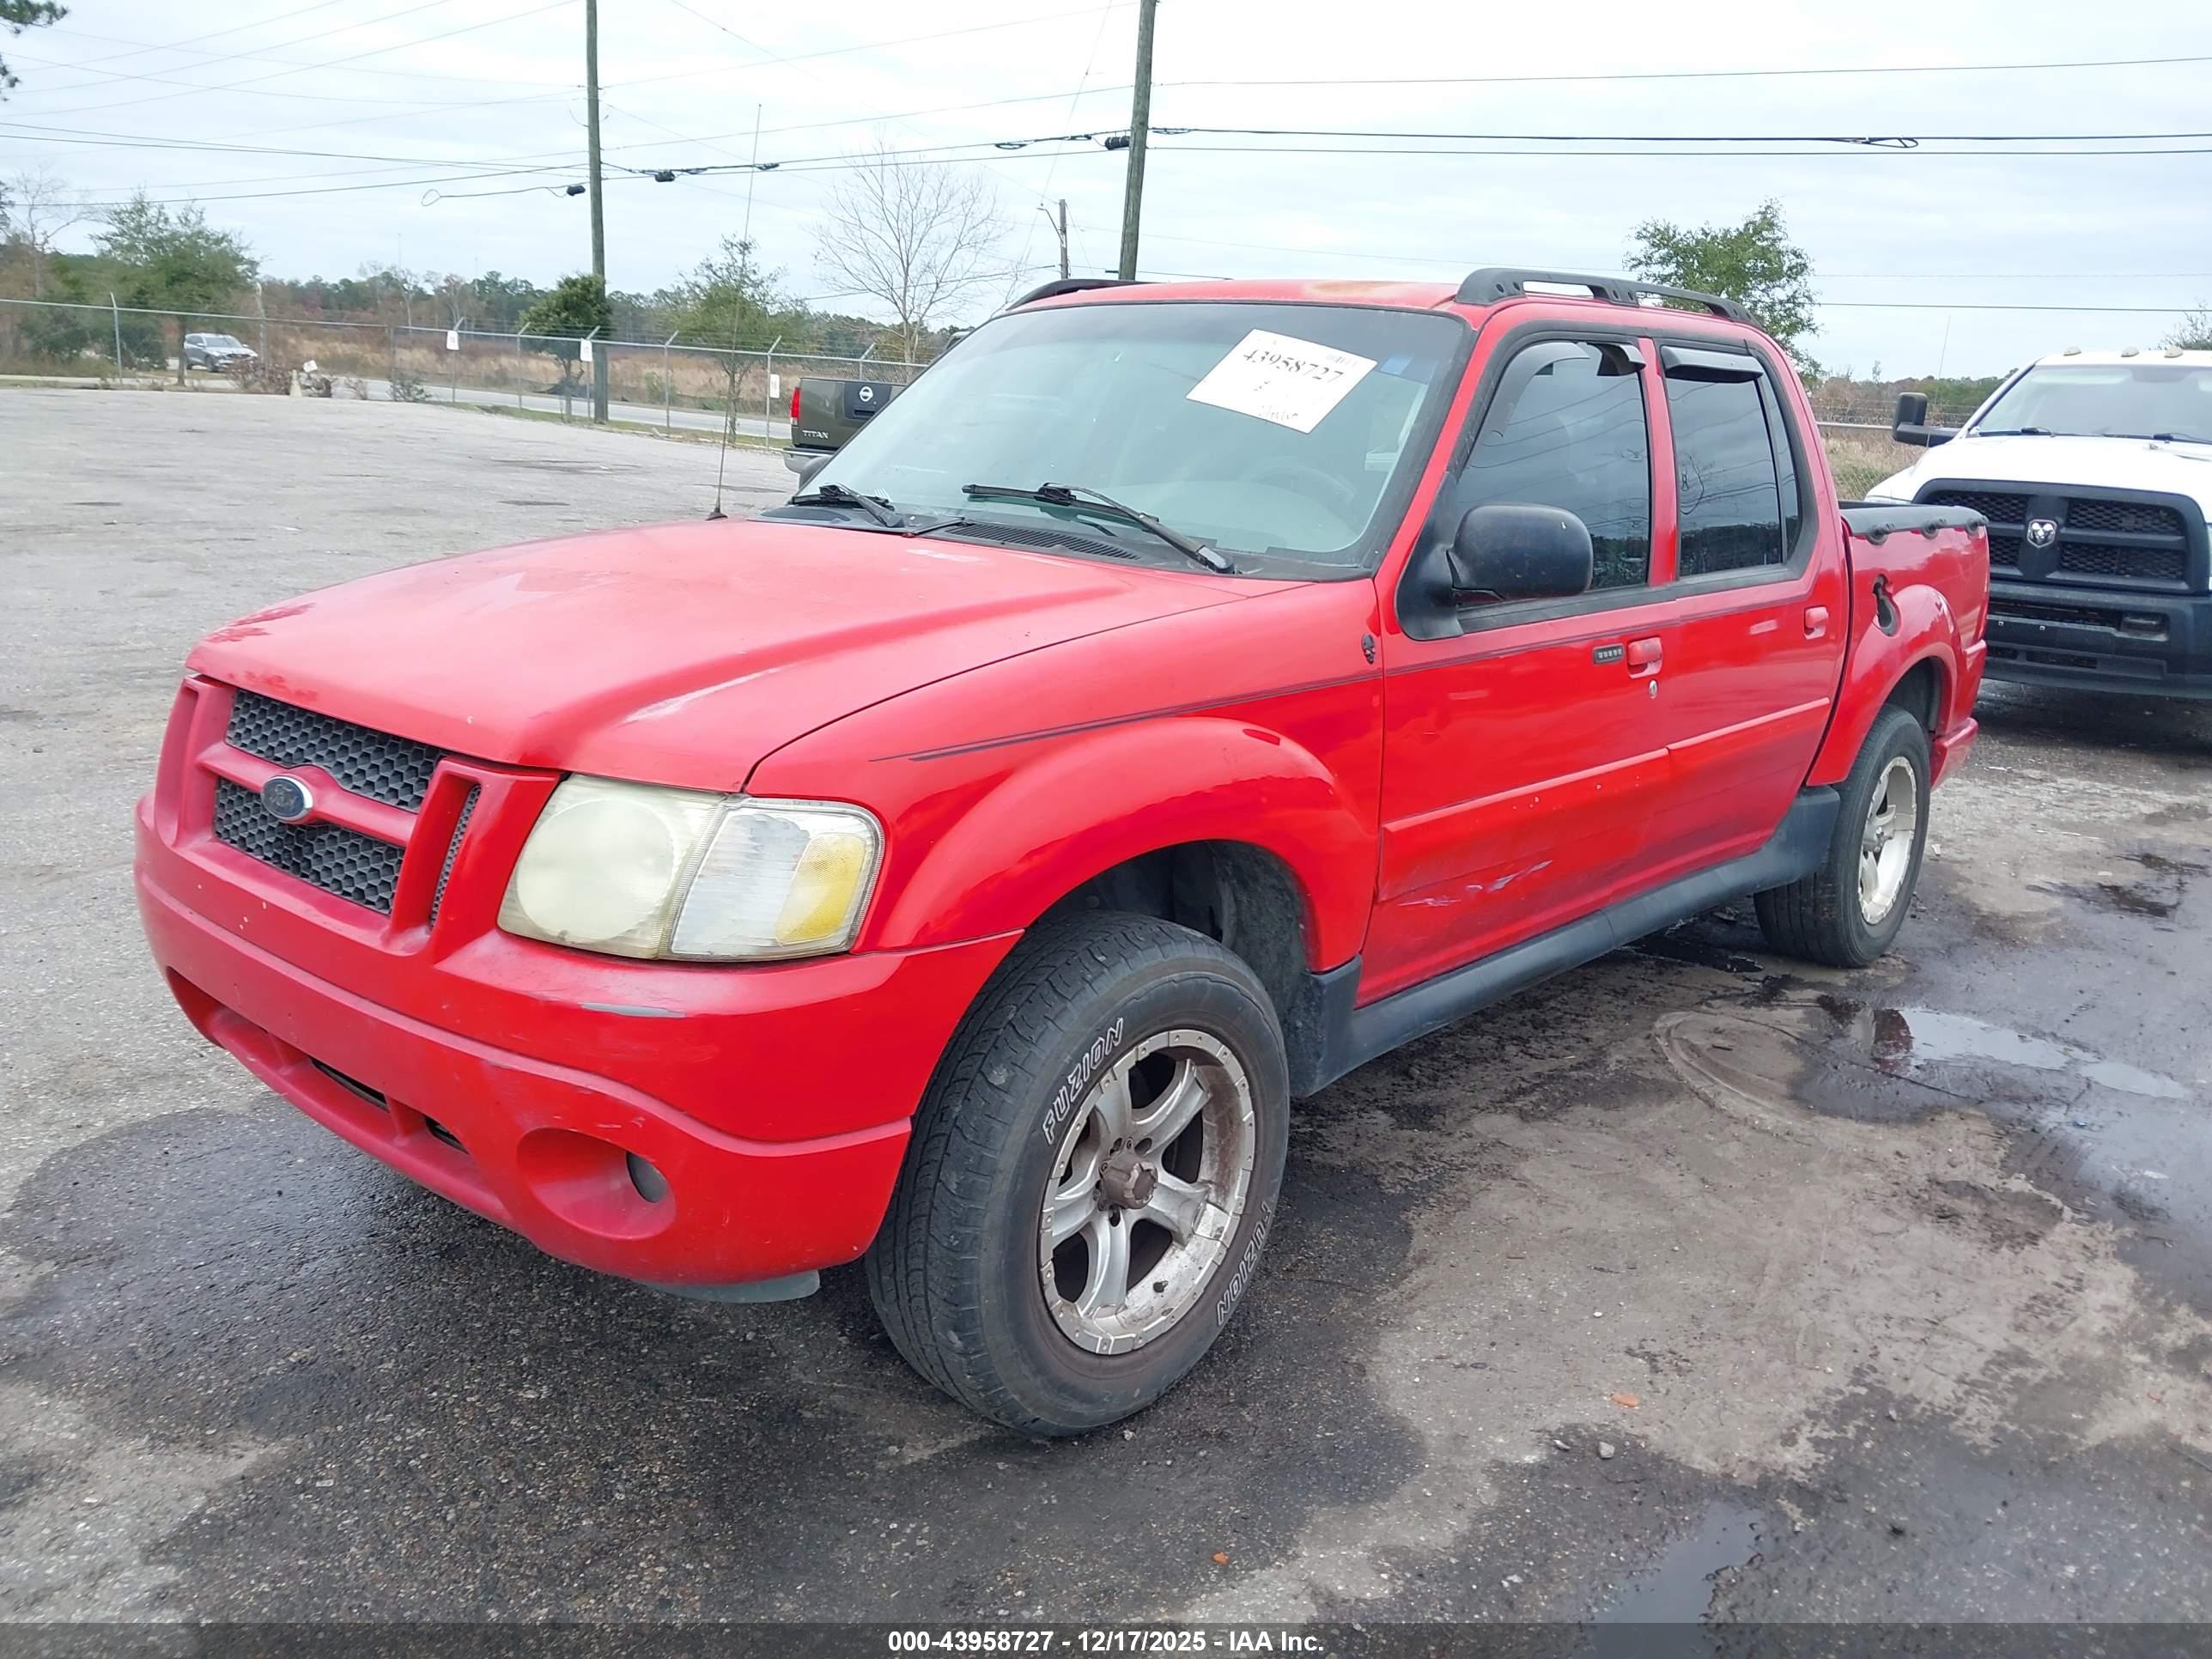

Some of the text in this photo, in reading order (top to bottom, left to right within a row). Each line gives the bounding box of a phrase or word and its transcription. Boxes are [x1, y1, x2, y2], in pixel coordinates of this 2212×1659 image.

[1243, 349, 1345, 383] 43958727
[802, 429, 830, 439] TITAN
[1042, 1018, 1123, 1145] FUZION
[1217, 1200, 1272, 1326] FUZION
